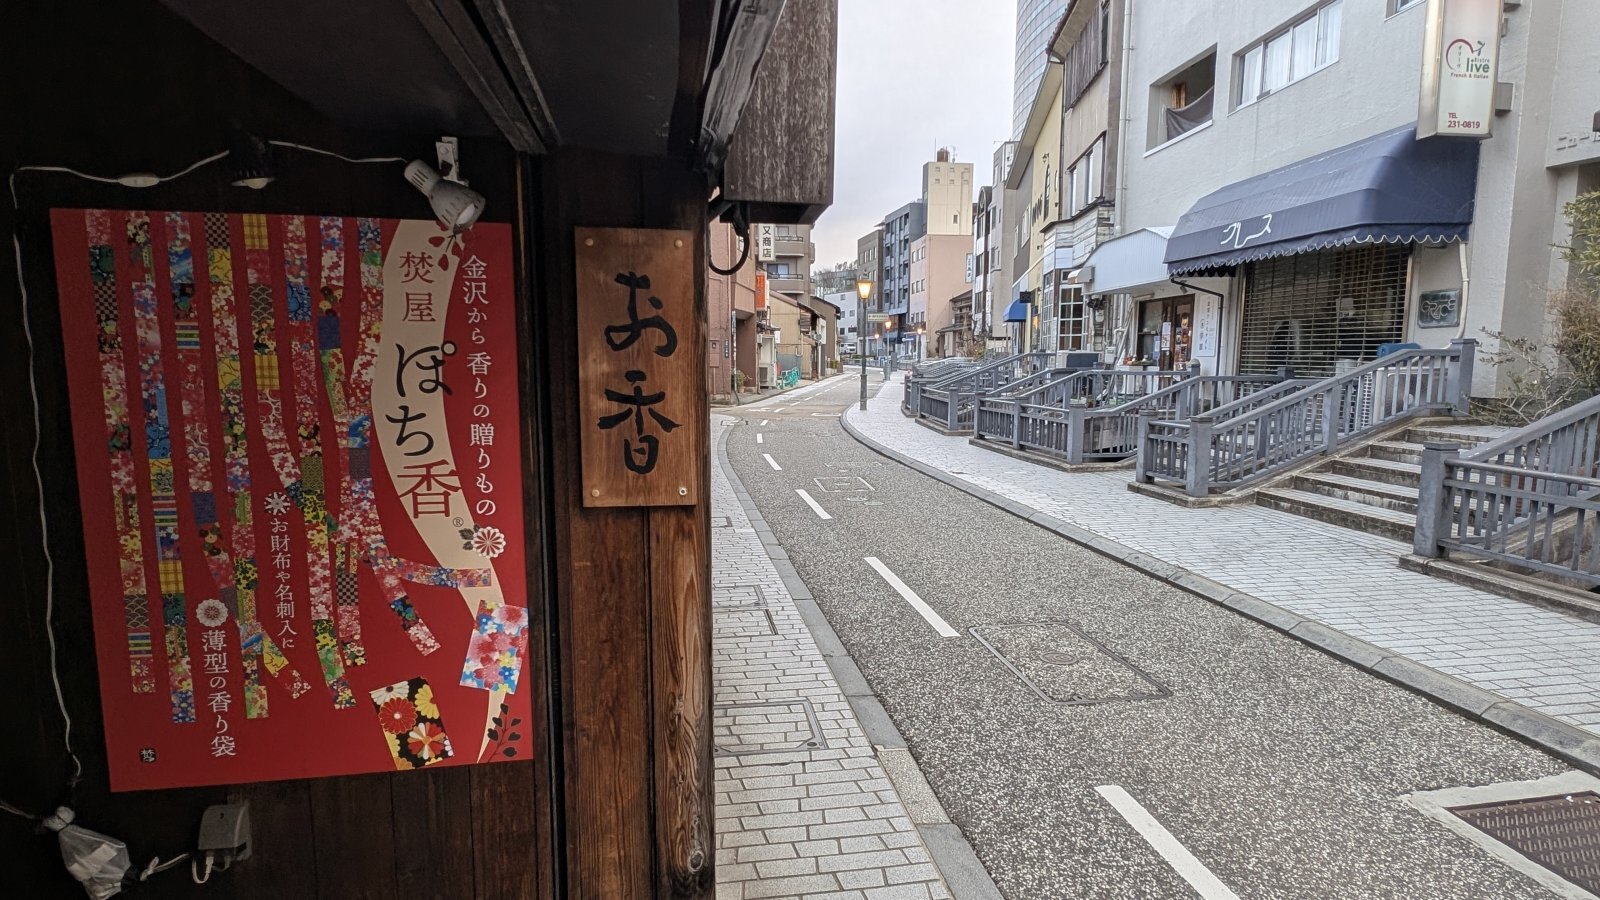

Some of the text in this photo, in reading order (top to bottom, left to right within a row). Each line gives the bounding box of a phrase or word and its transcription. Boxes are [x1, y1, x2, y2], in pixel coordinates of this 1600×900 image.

[1447, 120, 1481, 128] 231-0819
[763, 226, 771, 257] 又商店
[385, 251, 461, 518] 焚屋 ぽち香
[461, 254, 496, 516] 金沢から香りの贈りもの
[597, 271, 683, 474] お香
[270, 517, 298, 648] お財布や名刺入に
[200, 630, 237, 757] 薄型の香り袋
